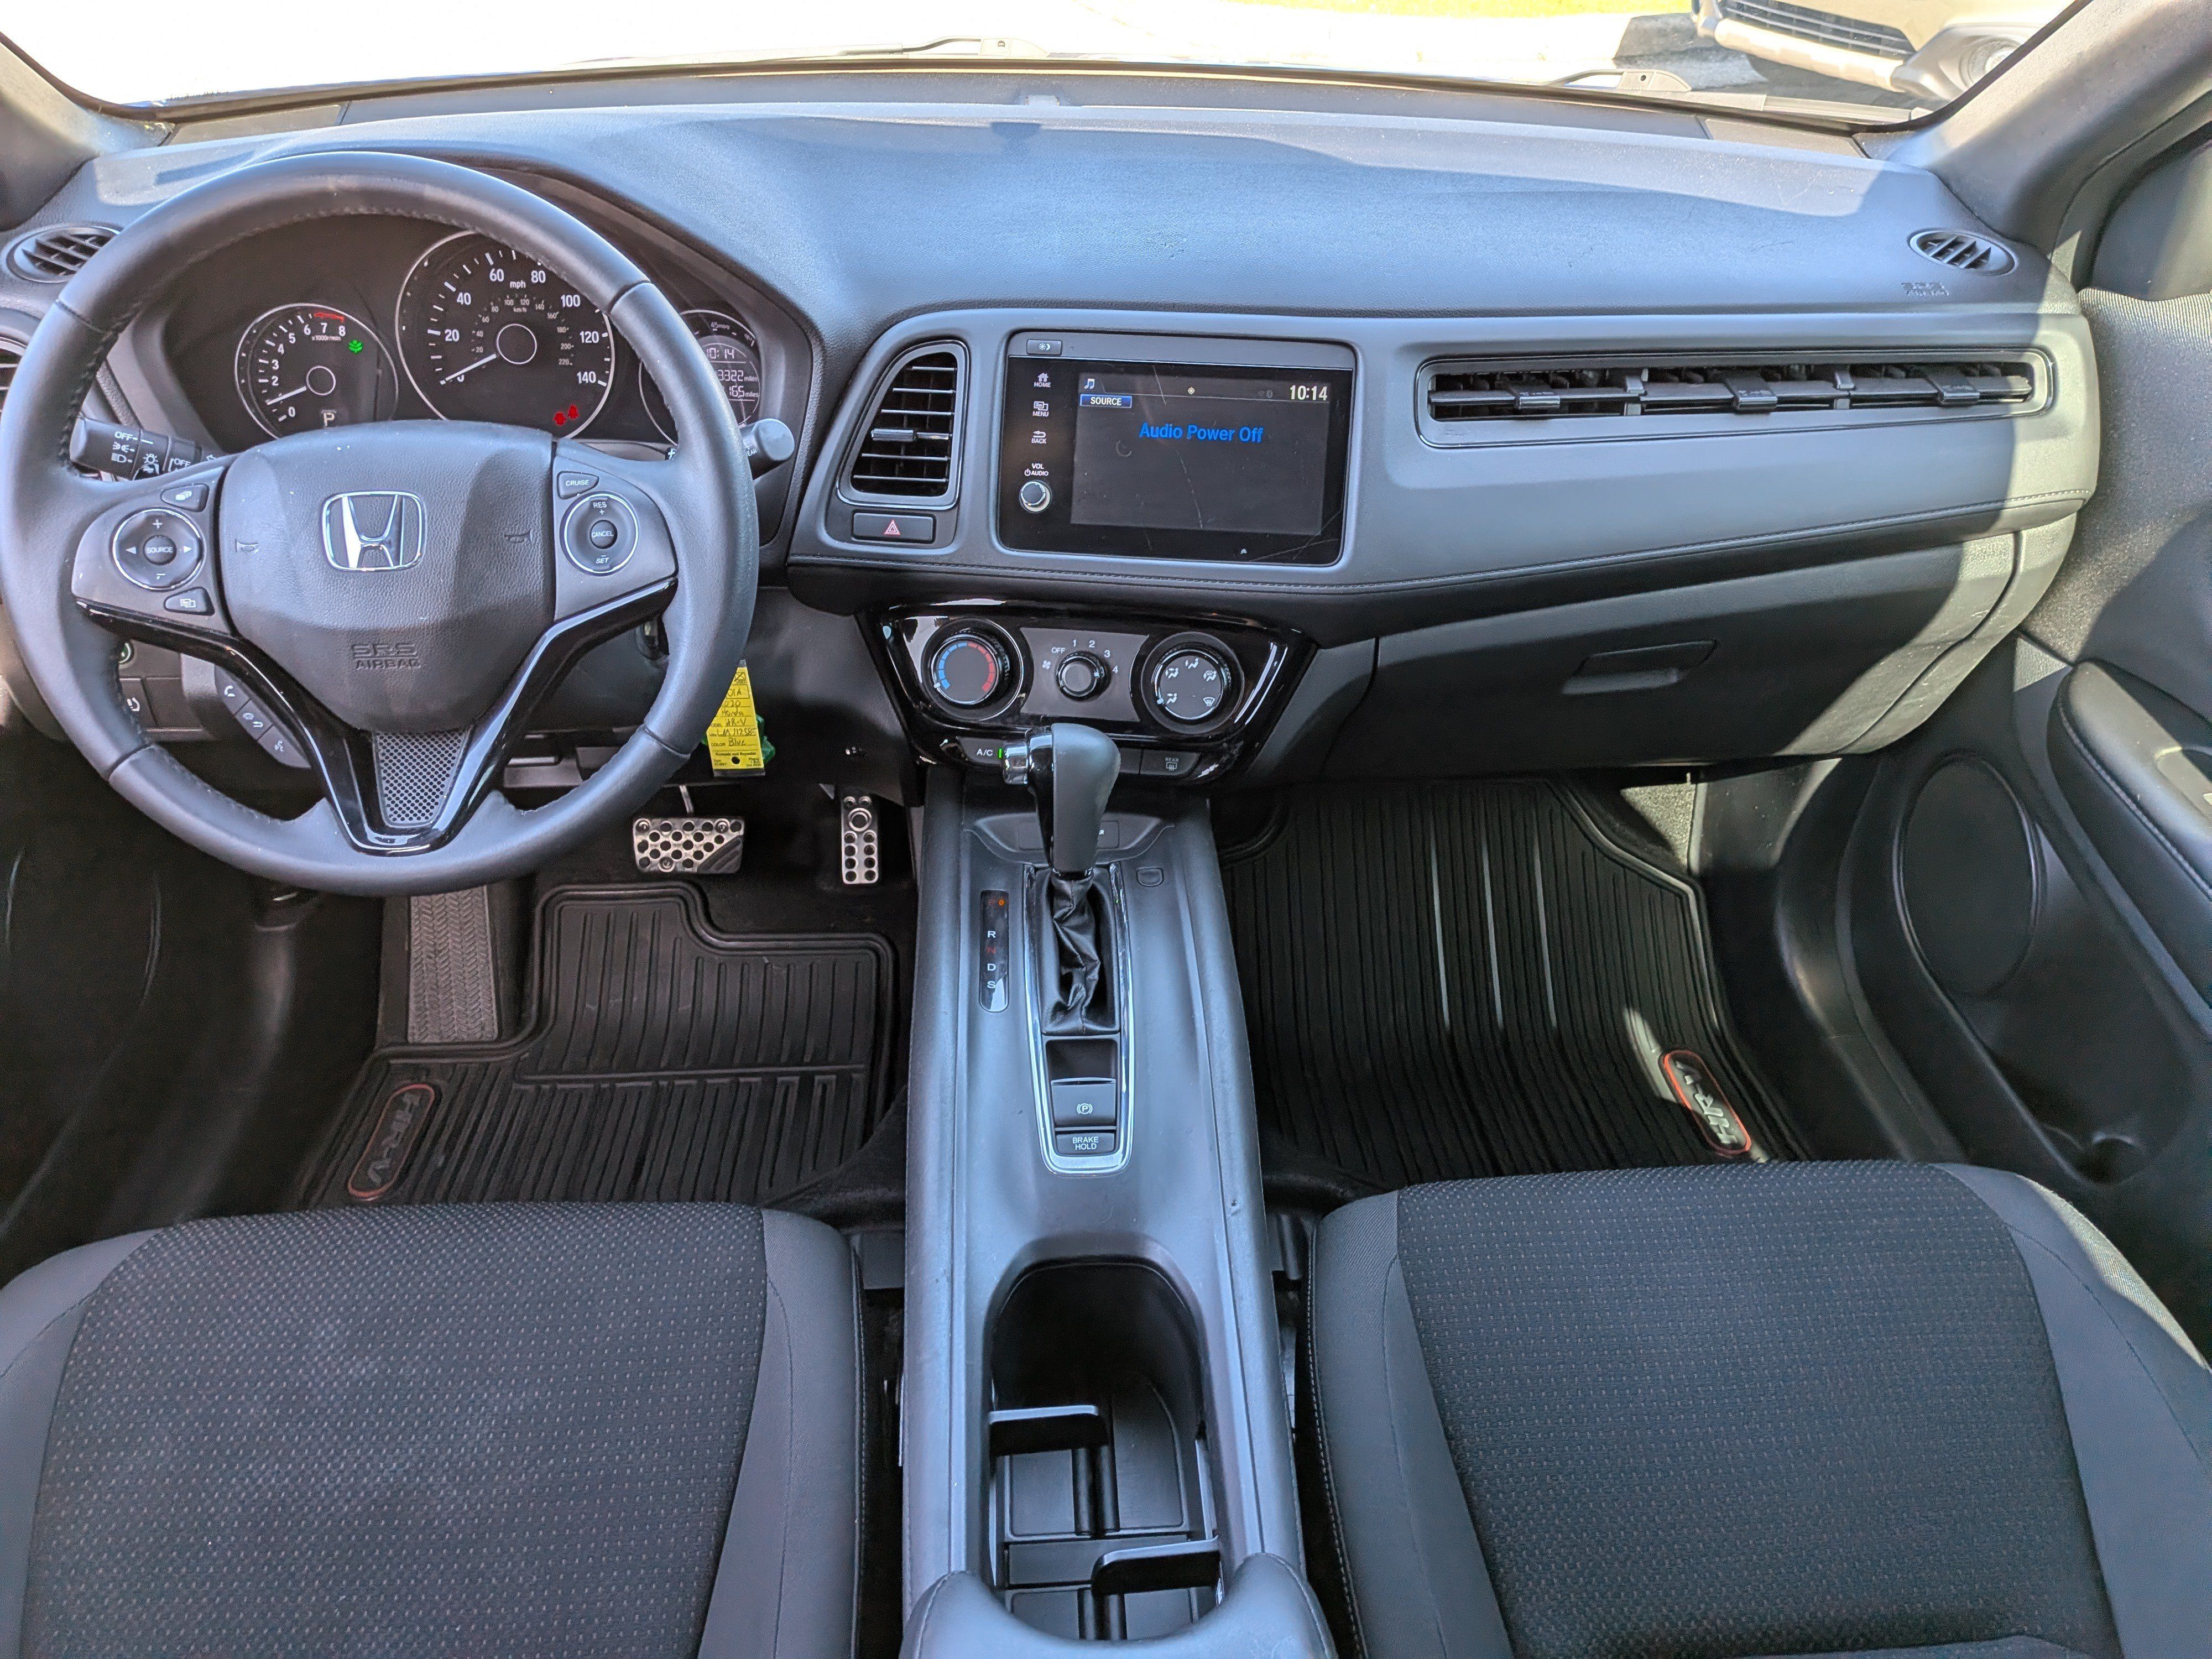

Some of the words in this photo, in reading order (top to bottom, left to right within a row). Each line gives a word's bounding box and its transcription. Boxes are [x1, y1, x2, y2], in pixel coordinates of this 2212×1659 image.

[489, 268, 504, 282] 60
[531, 269, 546, 284] 80
[509, 280, 526, 290] mph
[456, 293, 471, 305] 40
[560, 294, 581, 307] 100
[304, 324, 311, 335] 6
[321, 322, 328, 333] 7
[338, 325, 346, 337] 8
[288, 333, 296, 344] 5
[445, 330, 460, 342] 20
[580, 331, 599, 344] 120
[278, 343, 285, 354] 4
[272, 359, 279, 370] 3
[272, 376, 279, 386] 2
[577, 371, 596, 384] 140
[1289, 384, 1328, 401] 10:14
[1090, 397, 1122, 406] SOURCE
[288, 407, 296, 417] 0
[323, 412, 335, 426] P
[114, 431, 133, 441] OFF
[1139, 422, 1183, 439] Audio
[1187, 424, 1236, 441] Power
[1239, 426, 1264, 443] Off
[1089, 640, 1095, 648] 2
[1112, 665, 1119, 674] 4
[728, 737, 747, 746] Blue
[976, 748, 993, 757] A/C
